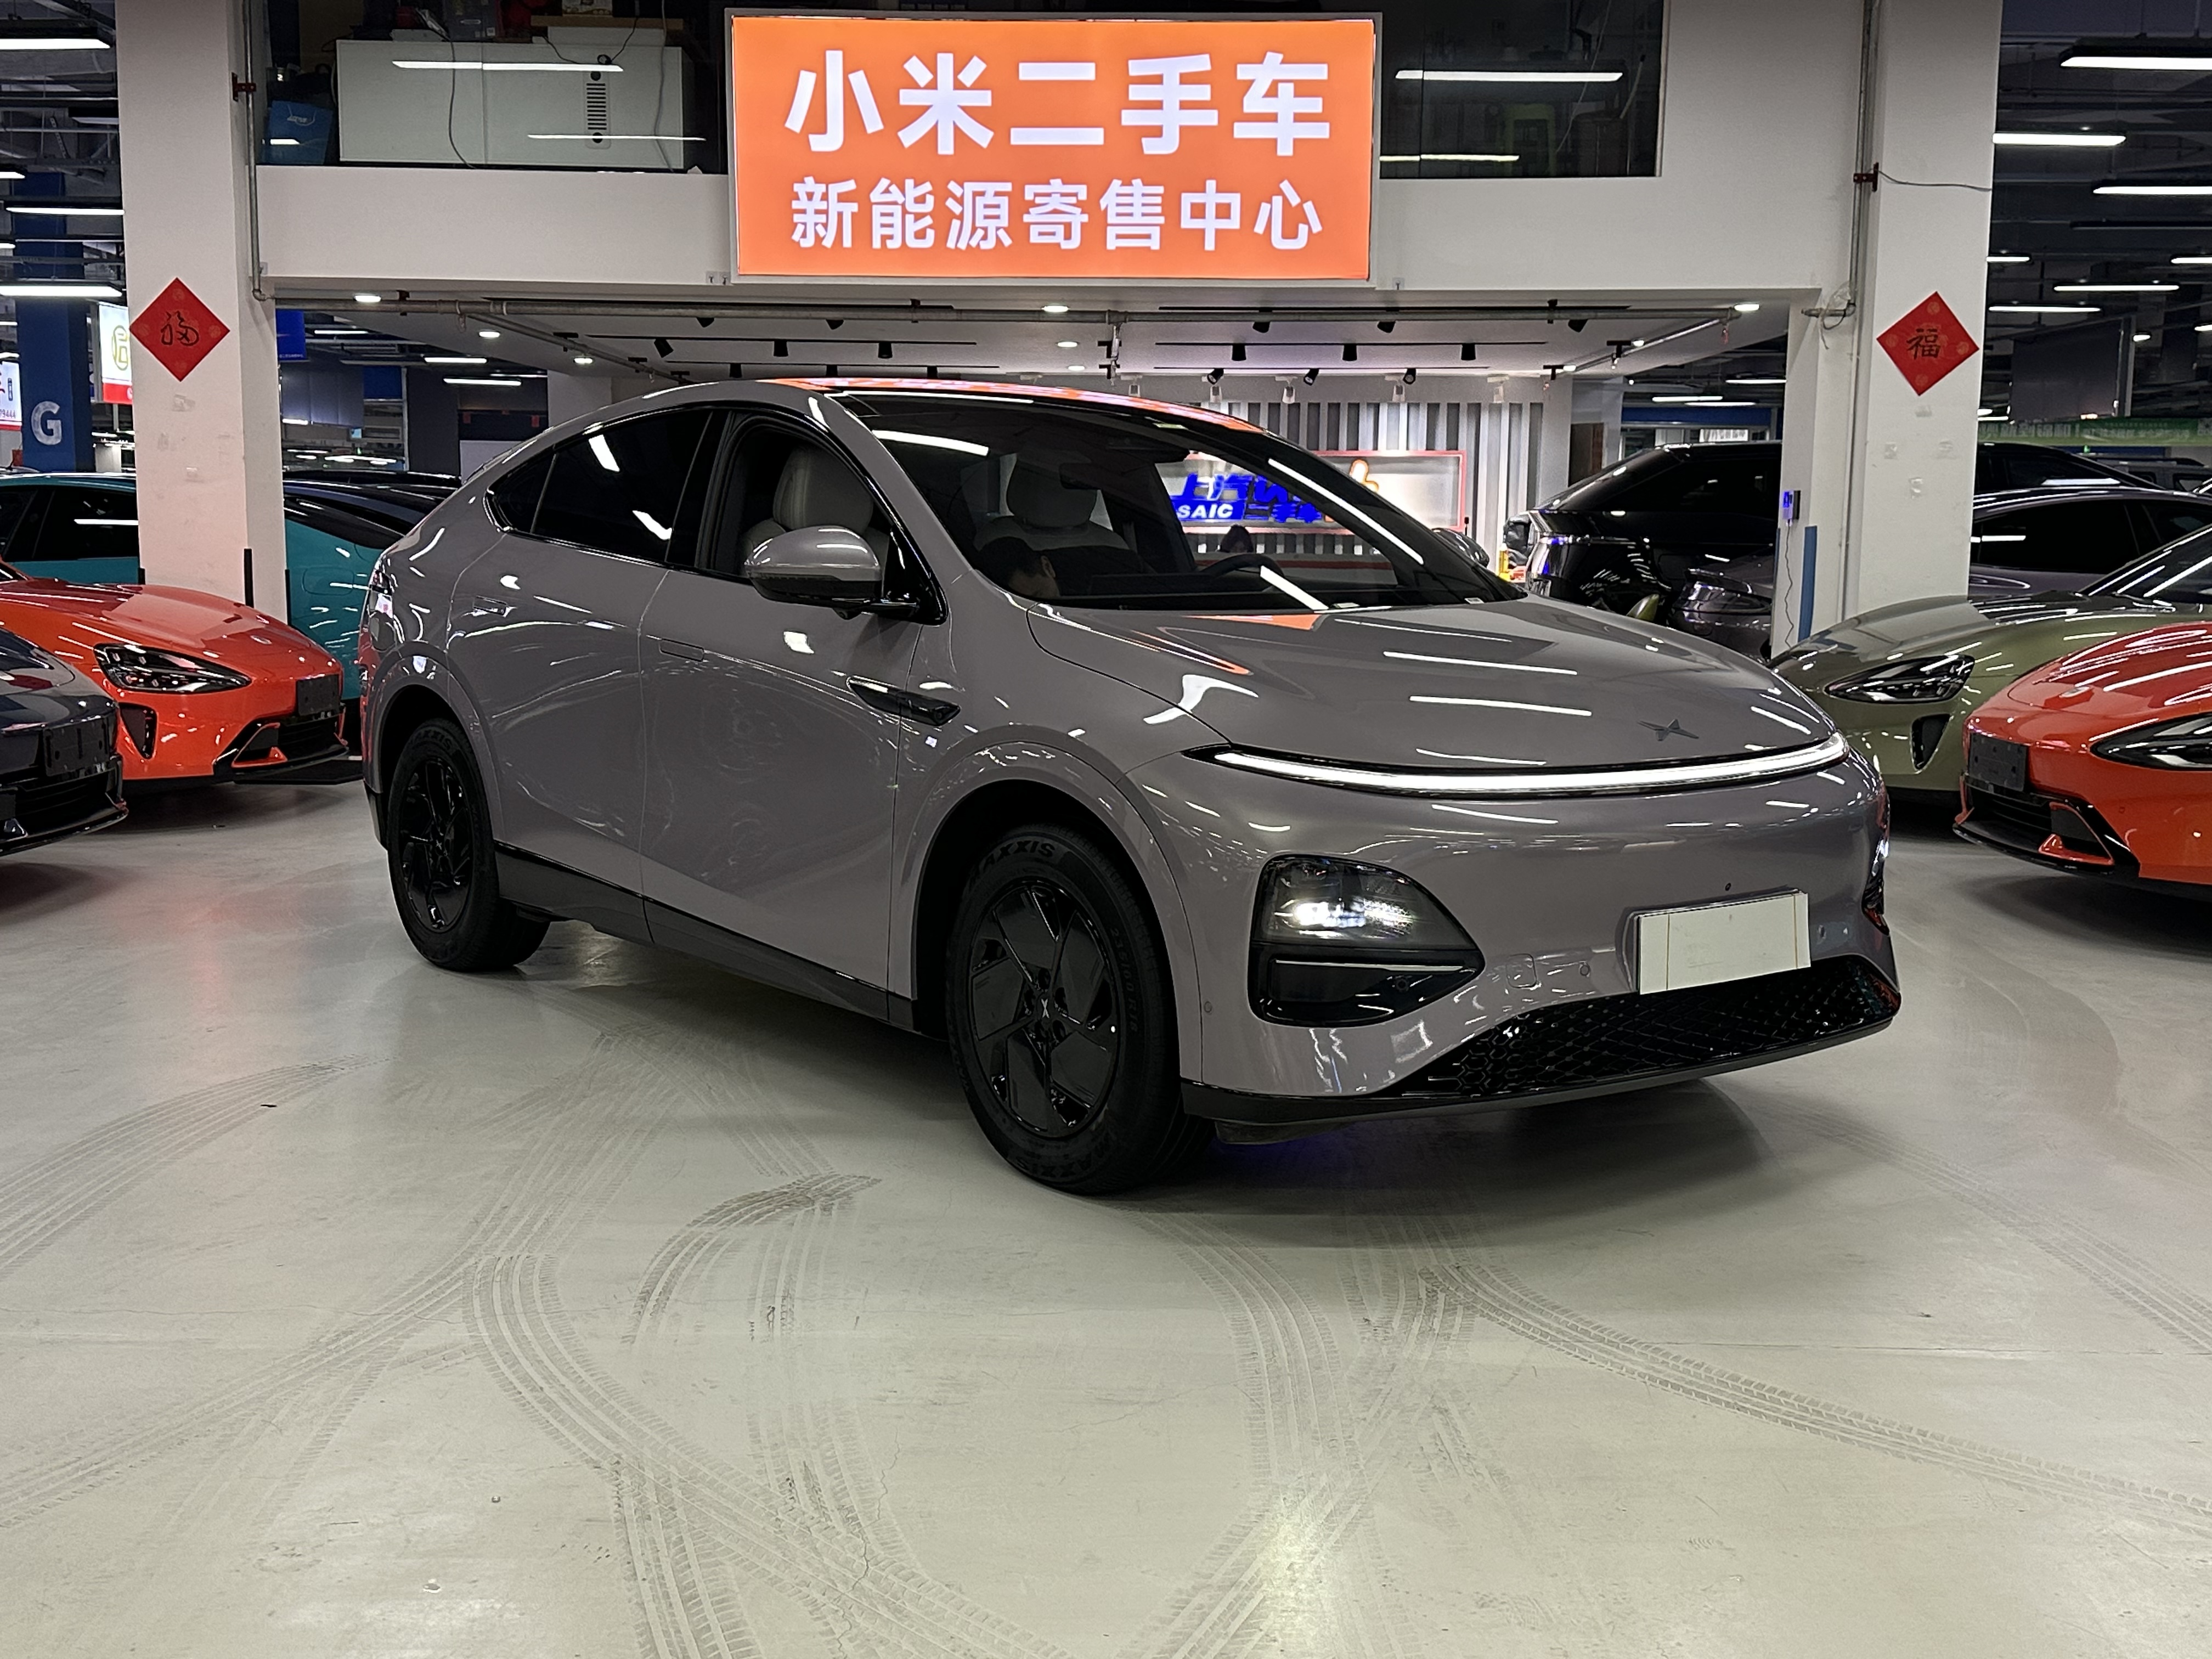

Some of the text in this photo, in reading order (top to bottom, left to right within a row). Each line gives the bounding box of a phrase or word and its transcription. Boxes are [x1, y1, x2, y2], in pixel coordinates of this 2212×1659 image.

[784, 50, 1330, 156] 小米二手车
[791, 176, 1323, 251] 新能源寄售中心
[160, 311, 199, 346] 福
[1906, 328, 1941, 359] 福
[31, 400, 63, 446] G
[1177, 504, 1234, 519] SAIC
